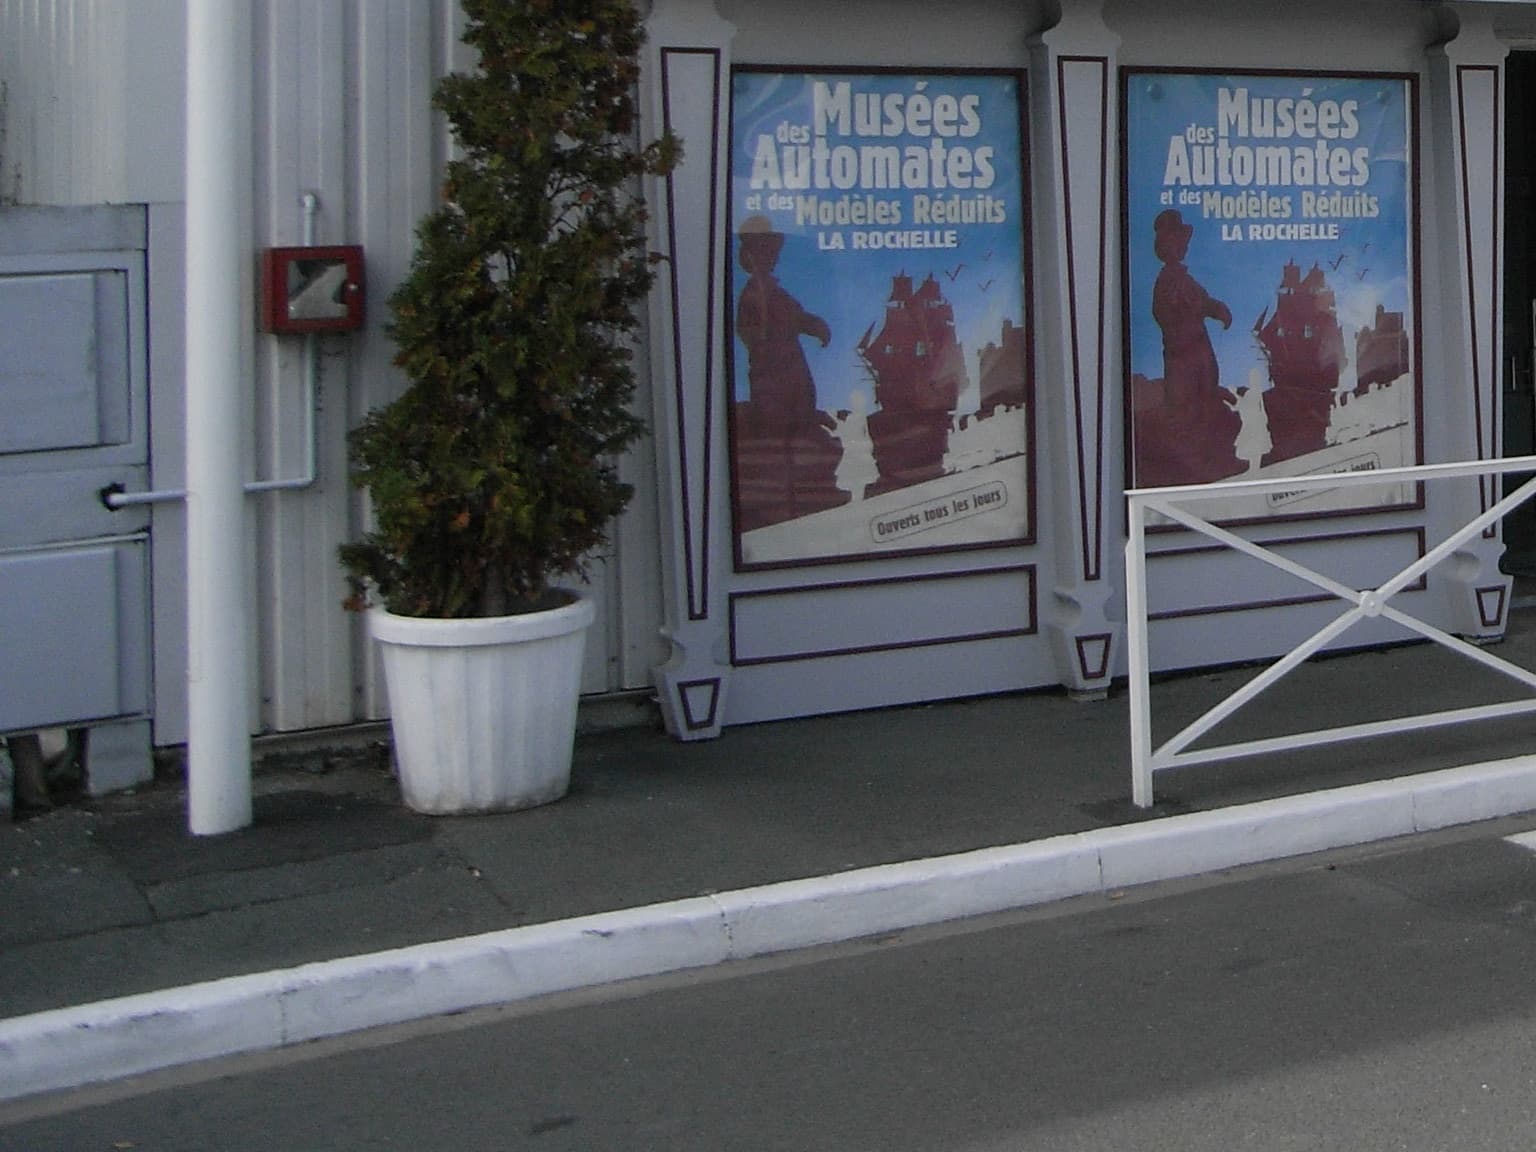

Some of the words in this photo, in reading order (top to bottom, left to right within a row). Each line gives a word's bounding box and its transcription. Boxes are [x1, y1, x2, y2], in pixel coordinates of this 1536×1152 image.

[813, 81, 981, 138] Musées
[1217, 87, 1360, 139] Musées
[776, 120, 810, 144] des
[1185, 123, 1215, 144] des
[750, 134, 997, 190] Automates
[1163, 135, 1370, 186] Automates
[746, 195, 761, 210] et
[768, 193, 794, 210] des
[797, 194, 901, 226] Modèles
[913, 193, 1006, 224] Réduits
[1160, 190, 1173, 205] et
[1179, 188, 1201, 205] des
[1203, 190, 1292, 219] Modèles
[1302, 189, 1379, 218] Réduits
[818, 232, 845, 251] LA
[853, 230, 958, 250] ROCHELLE
[1222, 224, 1243, 241] LA
[1249, 223, 1339, 241] ROCHELLE
[877, 513, 921, 536] Ouverts
[924, 504, 950, 525] tous
[953, 499, 969, 514] les
[973, 489, 1002, 509] jours
